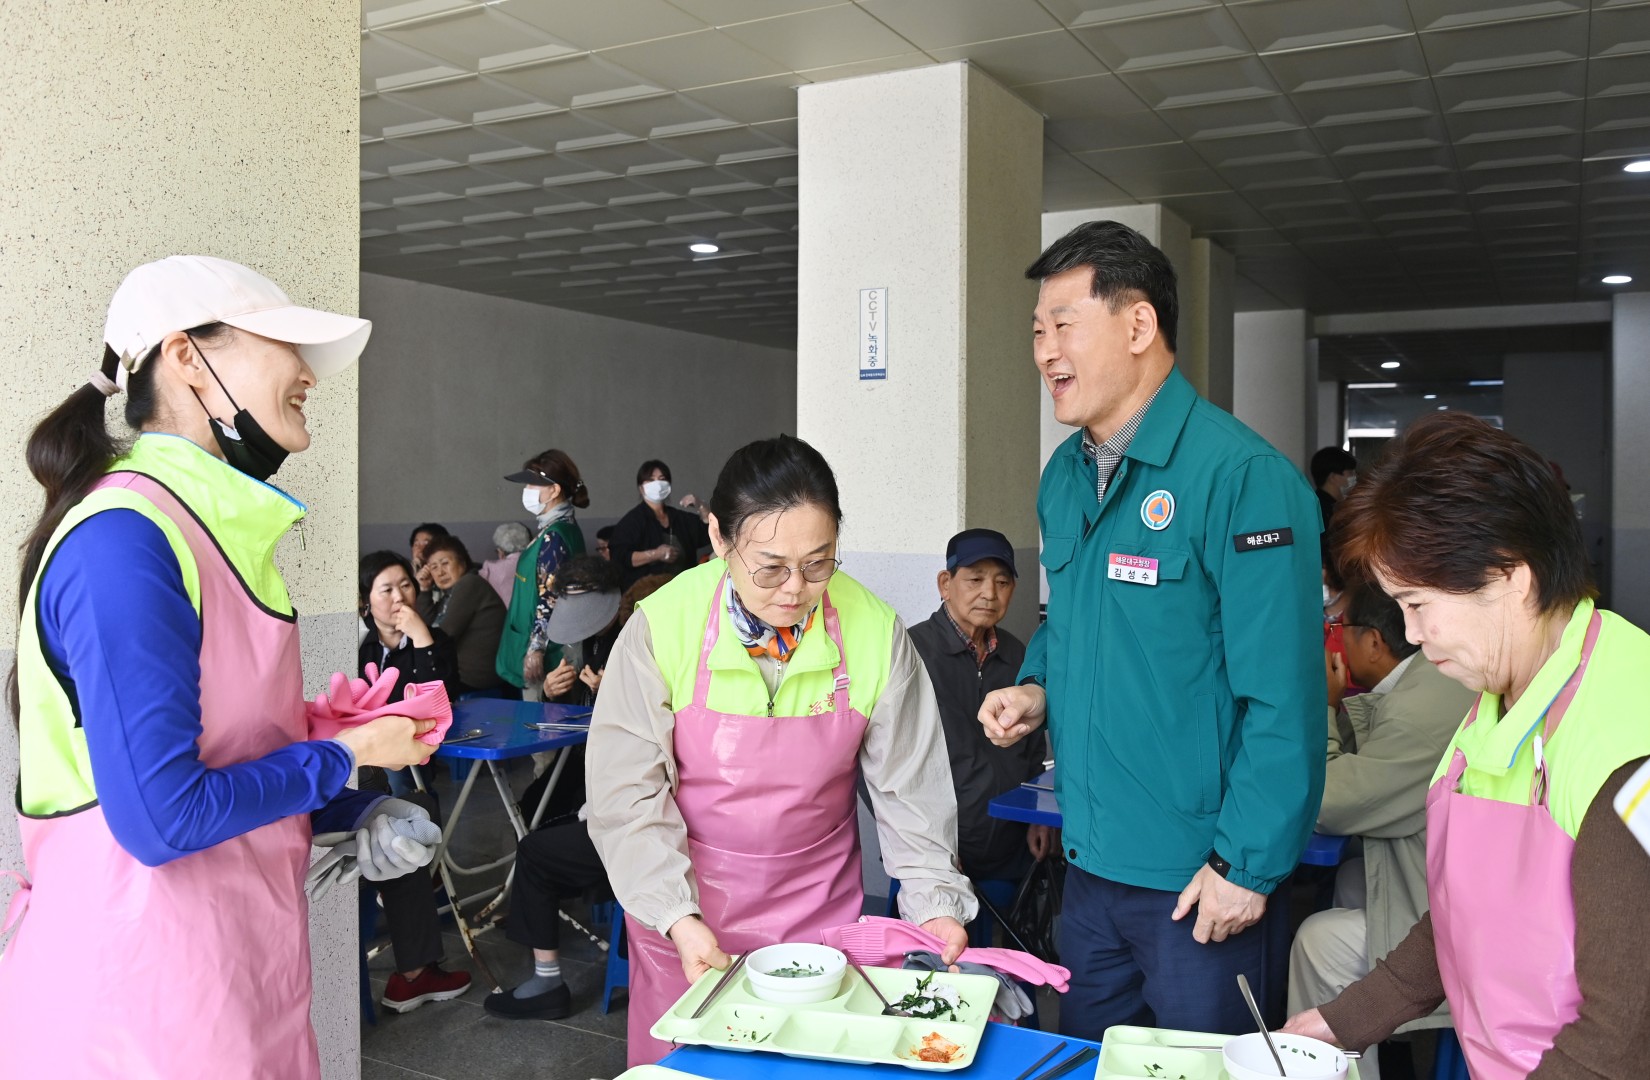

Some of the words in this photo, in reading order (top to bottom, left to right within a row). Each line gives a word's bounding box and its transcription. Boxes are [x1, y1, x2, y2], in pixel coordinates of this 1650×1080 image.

[868, 290, 878, 332] CCTV
[867, 333, 879, 368] 녹화중
[1246, 532, 1280, 546] 해운대구
[1115, 556, 1151, 568] 해운대구청장
